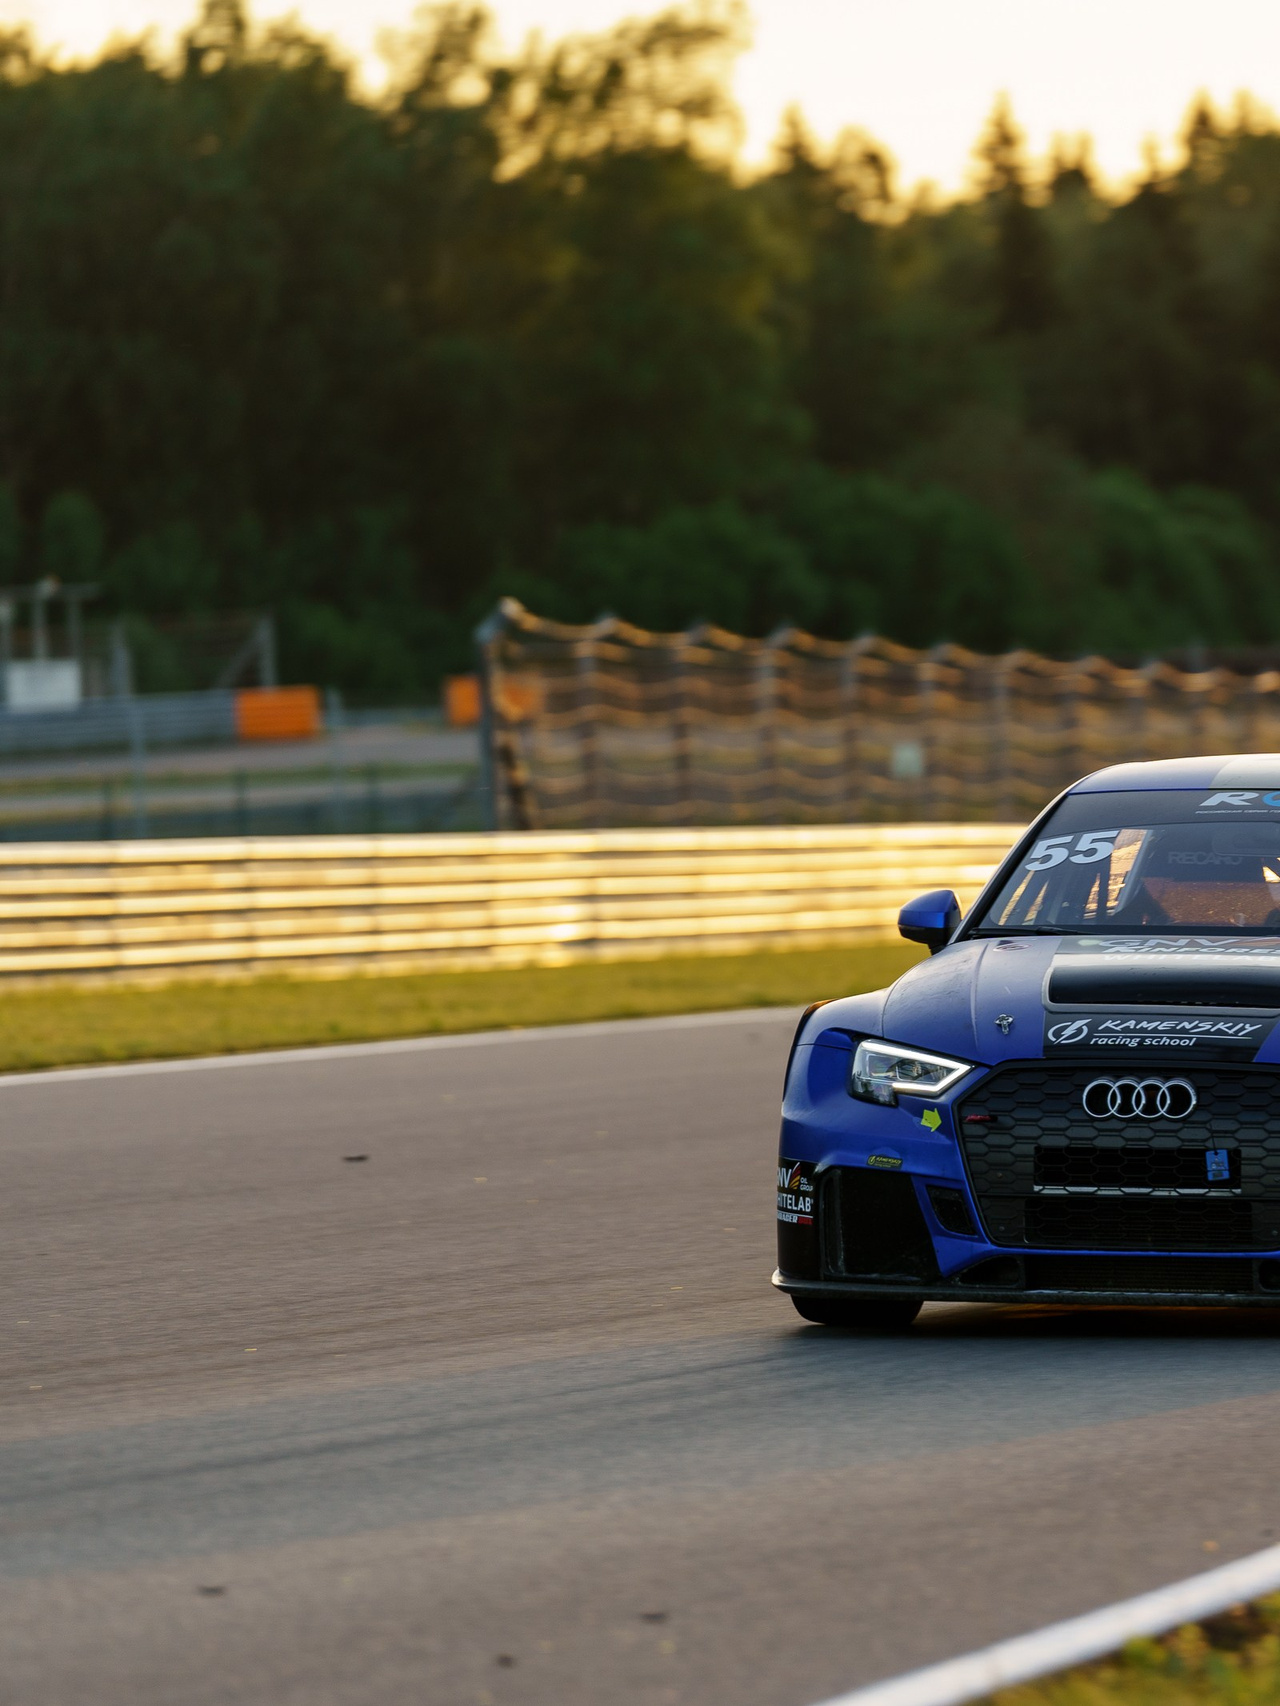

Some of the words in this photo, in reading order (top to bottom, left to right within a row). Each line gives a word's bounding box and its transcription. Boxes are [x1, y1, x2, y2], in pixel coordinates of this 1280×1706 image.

[1024, 830, 1120, 872] 55
[1098, 938, 1241, 947] GNV
[1097, 1019, 1263, 1036] KAMENSKIY
[1089, 1036, 1141, 1047] racing
[1143, 1036, 1198, 1046] school
[777, 1166, 792, 1188] NV
[777, 1192, 812, 1212] HITELAB
